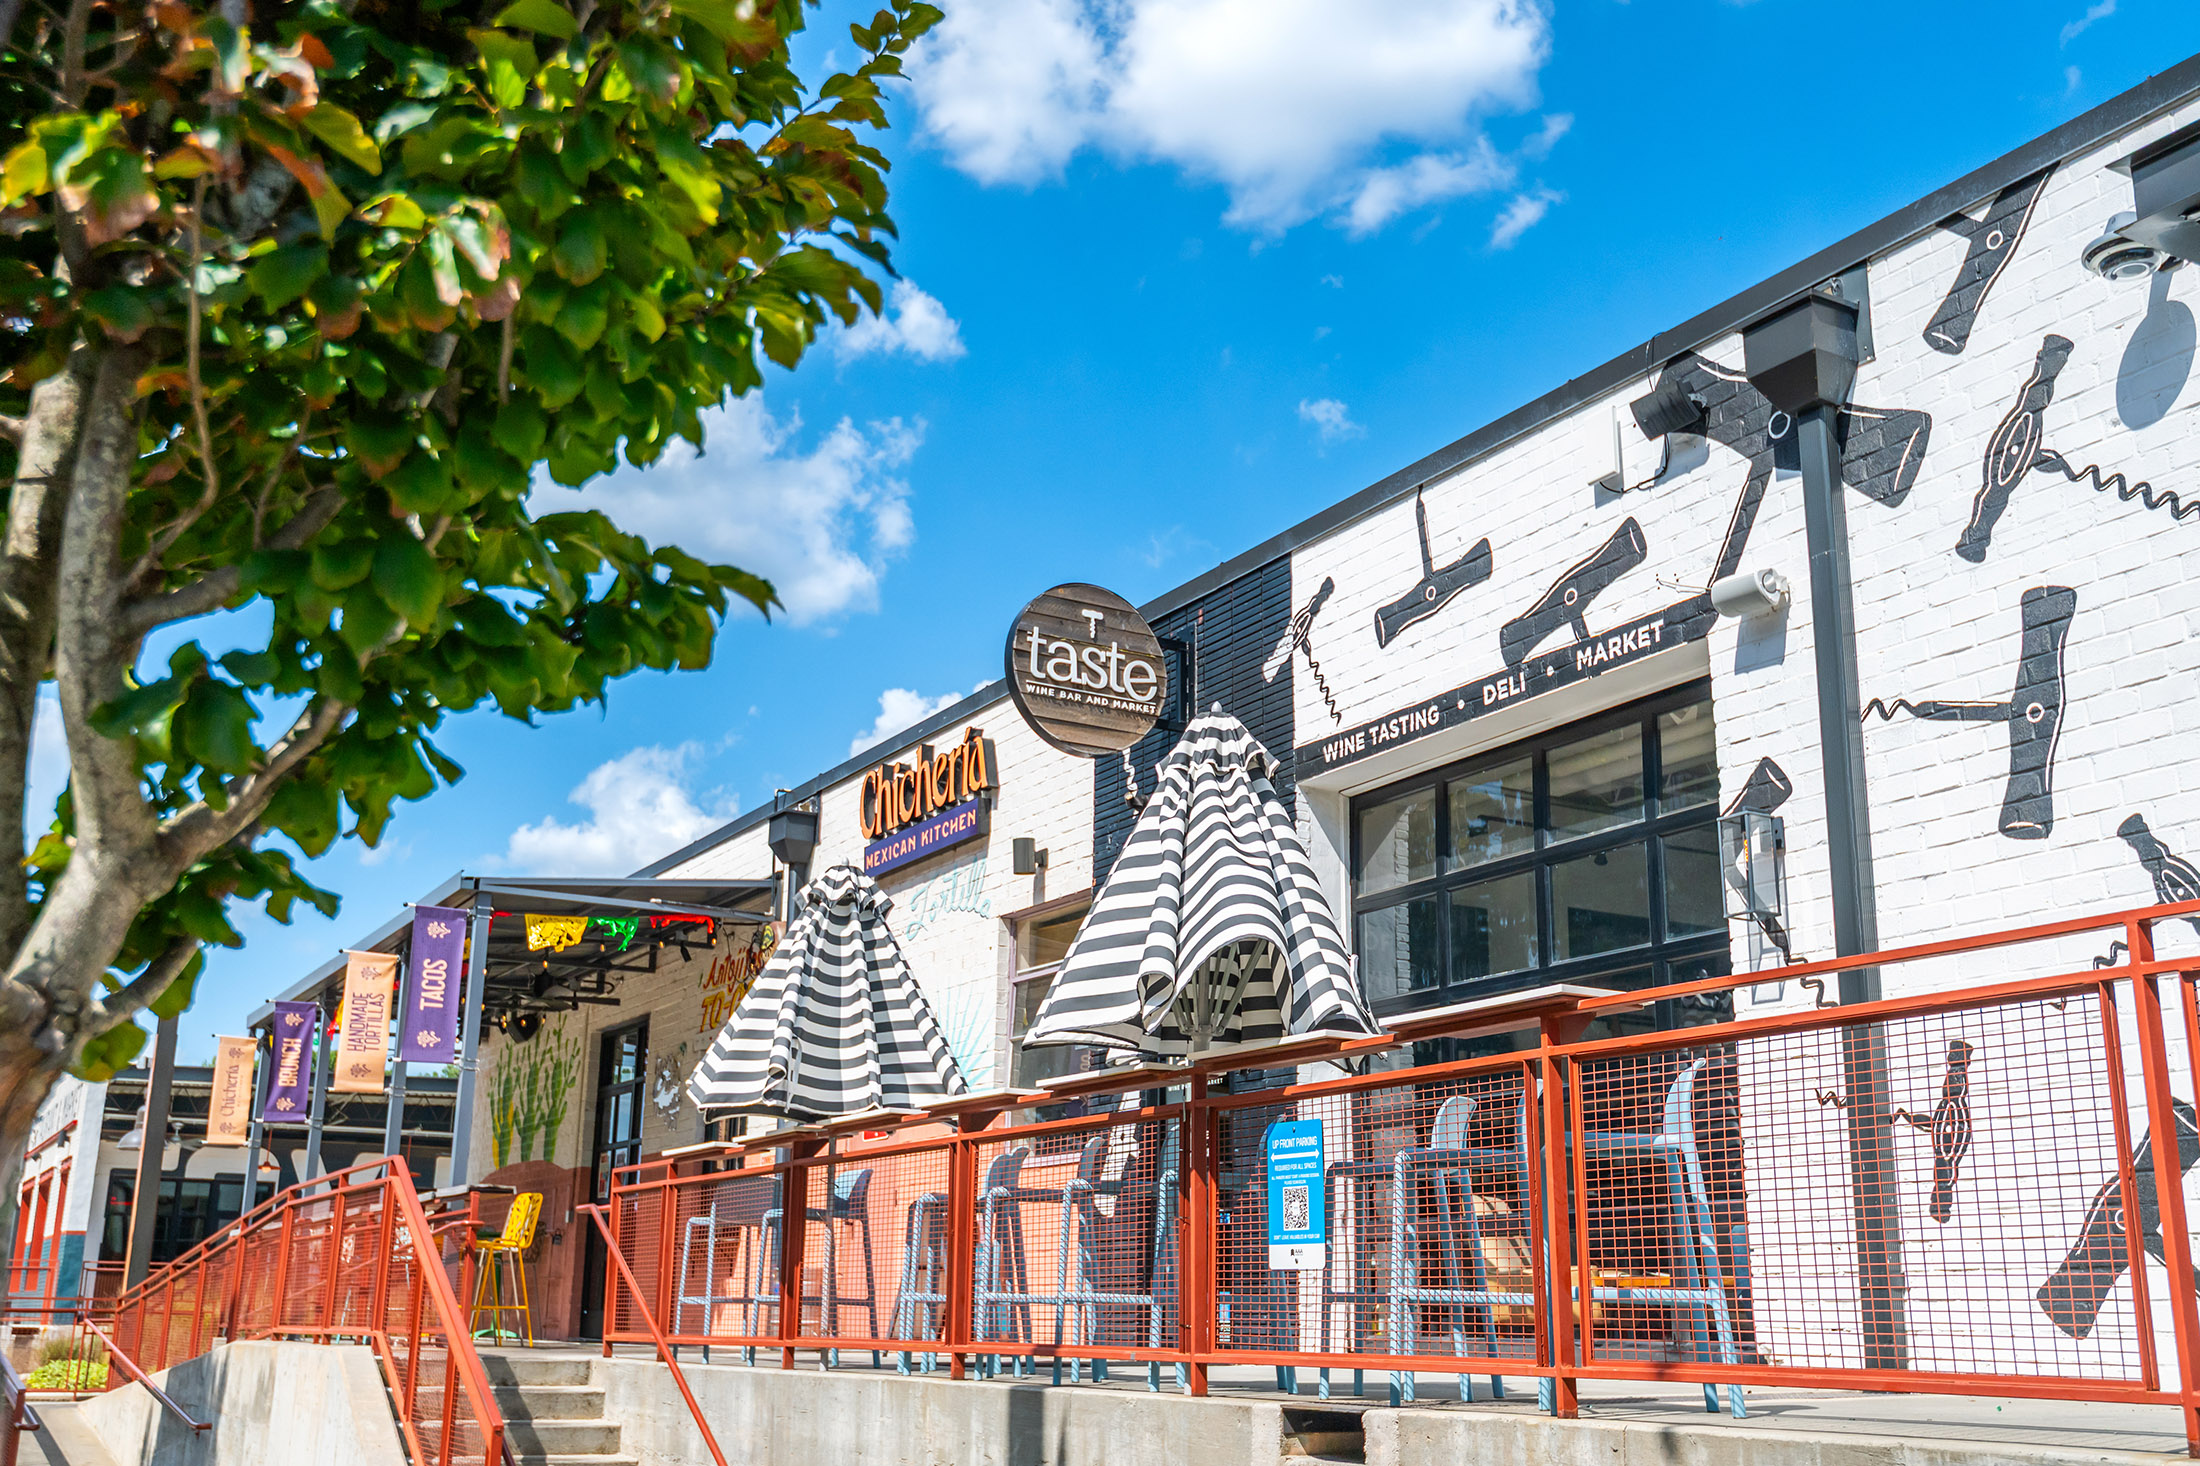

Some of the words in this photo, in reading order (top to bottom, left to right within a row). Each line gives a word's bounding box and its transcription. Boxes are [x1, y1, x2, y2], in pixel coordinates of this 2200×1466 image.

[1027, 626, 1157, 702] taste
[1322, 731, 1366, 763] WINE
[1369, 704, 1440, 746] TASTING
[1482, 671, 1527, 706] DELI
[1576, 619, 1664, 671] MARKET
[1026, 684, 1054, 697] WINE
[1060, 690, 1082, 702] BAR
[1087, 695, 1109, 707] AND
[1113, 700, 1156, 715] MARKET
[860, 726, 988, 839] Chichería
[866, 835, 916, 870] MEXICAN
[921, 809, 977, 847] KITCHEN
[906, 857, 992, 941] Tortilla
[419, 958, 448, 1011] TACOS
[347, 992, 369, 1052] HANDMADE
[363, 992, 385, 1053] TORTILLAS
[278, 1038, 302, 1087] BRUNCH
[1272, 1139, 1279, 1149] UP
[1280, 1138, 1295, 1149] FRONT
[1296, 1135, 1318, 1147] PARKING
